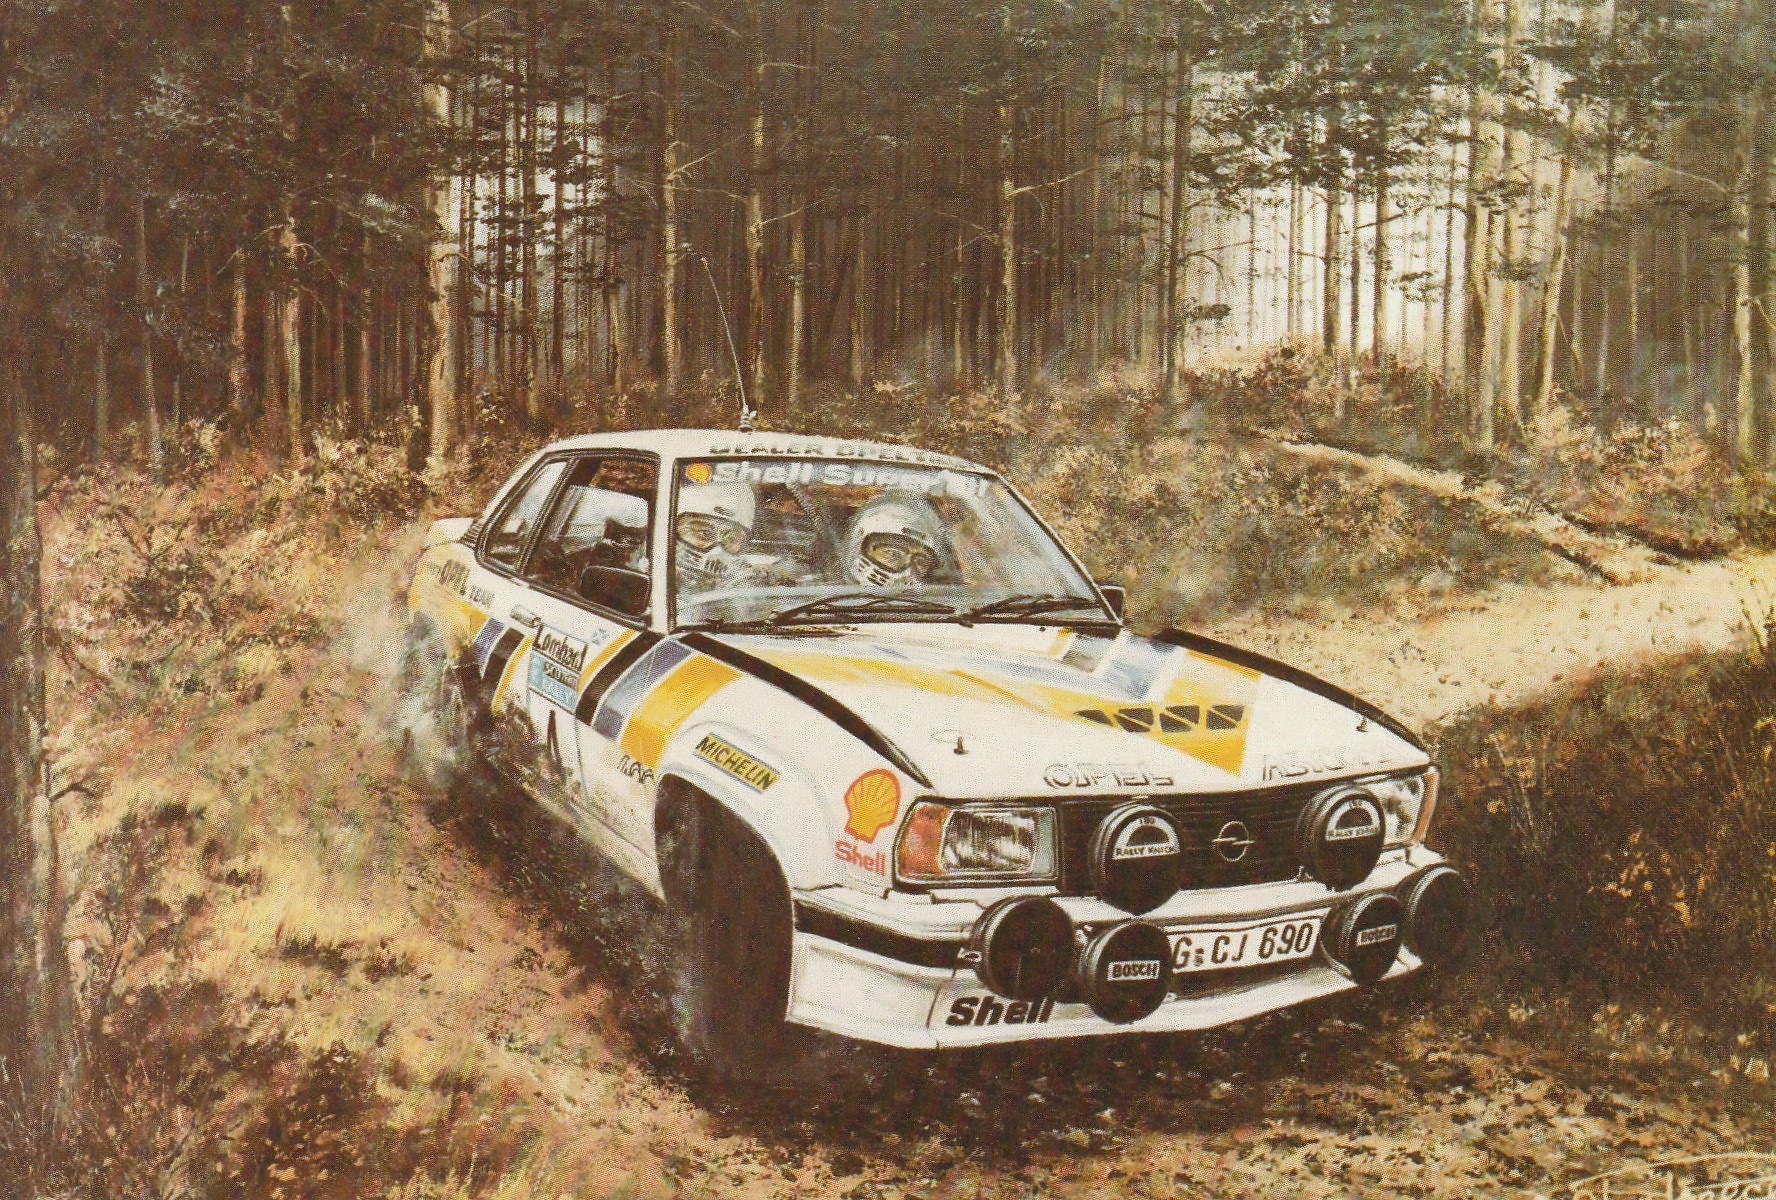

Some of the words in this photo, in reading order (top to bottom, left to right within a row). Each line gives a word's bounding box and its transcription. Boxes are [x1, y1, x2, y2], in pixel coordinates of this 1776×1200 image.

[711, 460, 814, 486] Shell
[695, 736, 774, 791] MICHELIN
[1043, 762, 1174, 790] OPEL
[835, 839, 886, 877] Shell
[1115, 845, 1145, 857] RALLY
[1258, 922, 1314, 960] 690
[1112, 960, 1159, 979] BOSCH
[946, 995, 1054, 1027] Shell
